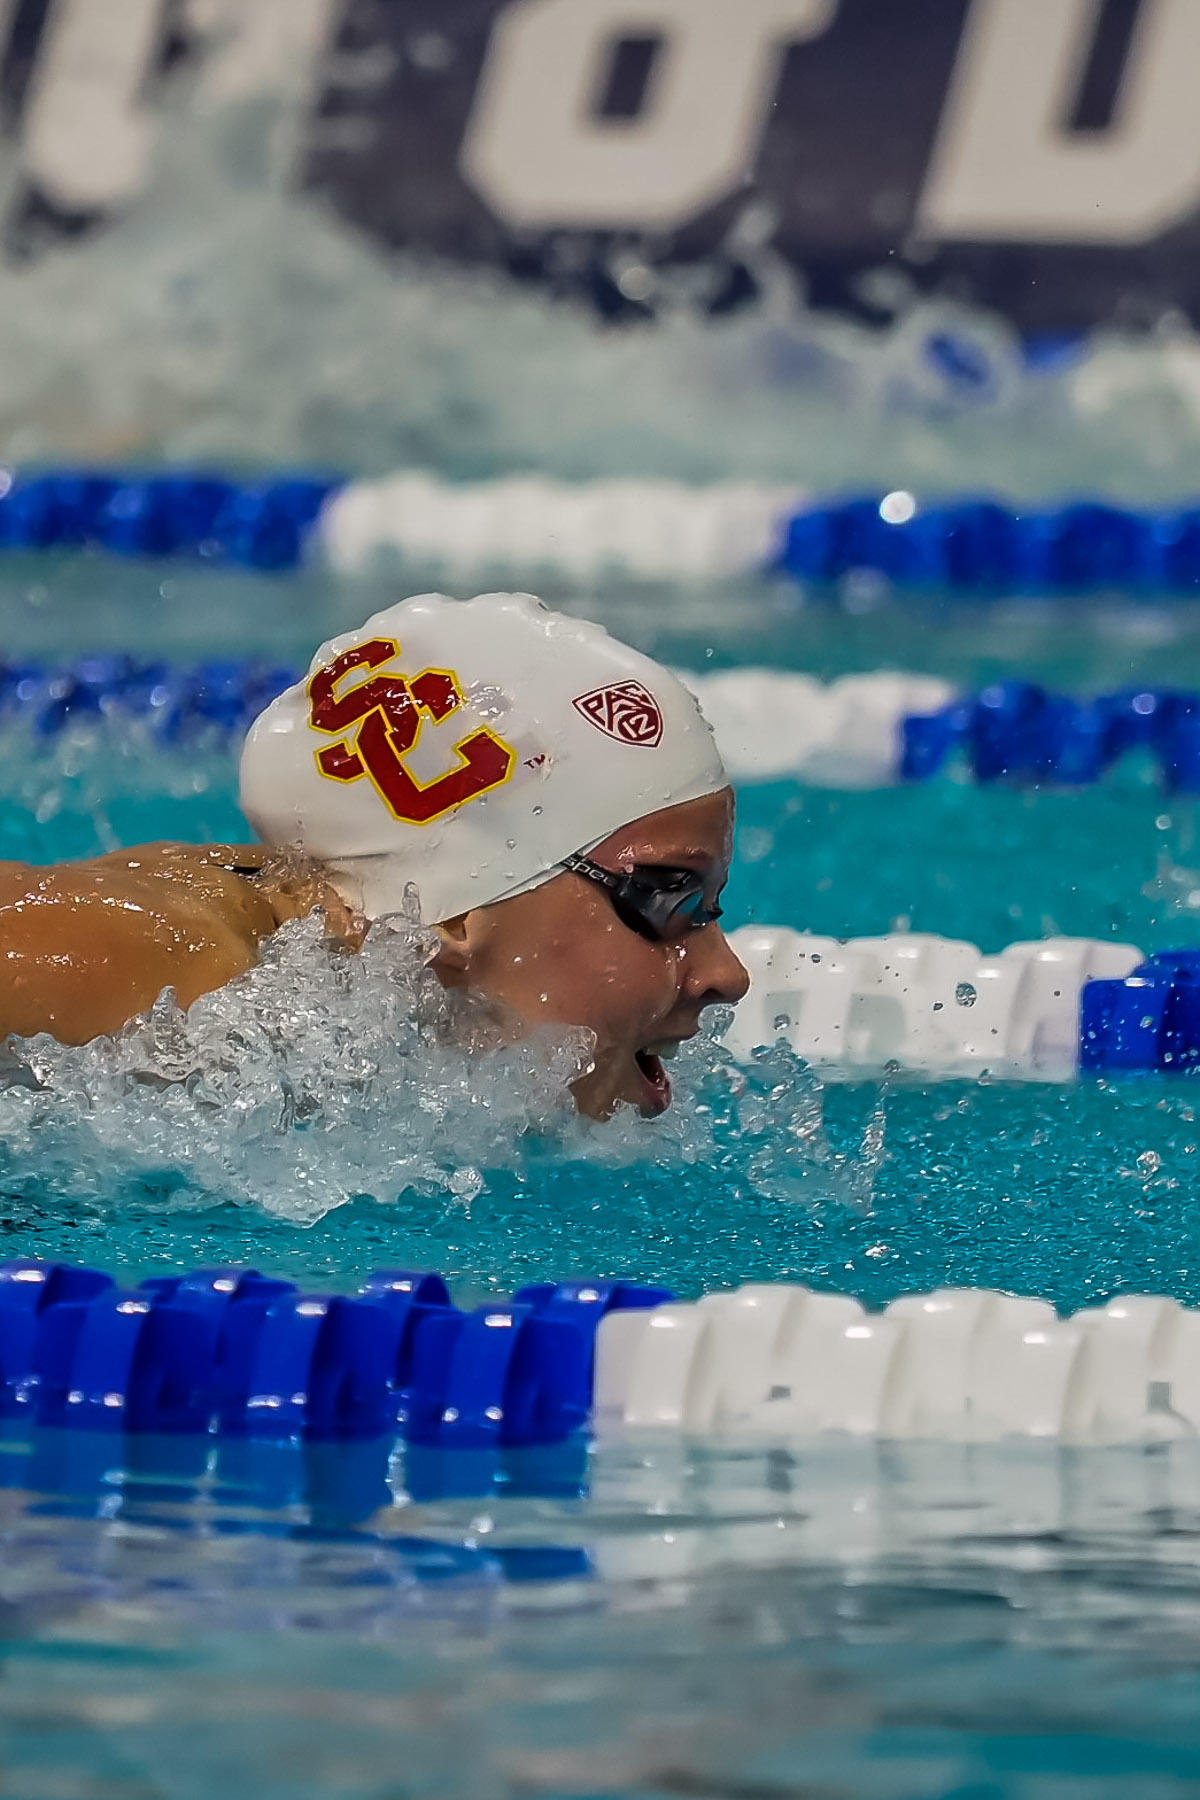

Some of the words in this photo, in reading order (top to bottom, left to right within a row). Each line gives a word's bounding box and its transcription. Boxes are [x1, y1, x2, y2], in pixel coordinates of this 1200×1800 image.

[309, 638, 516, 824] SC
[580, 683, 655, 732] PAC
[621, 713, 655, 738] 12
